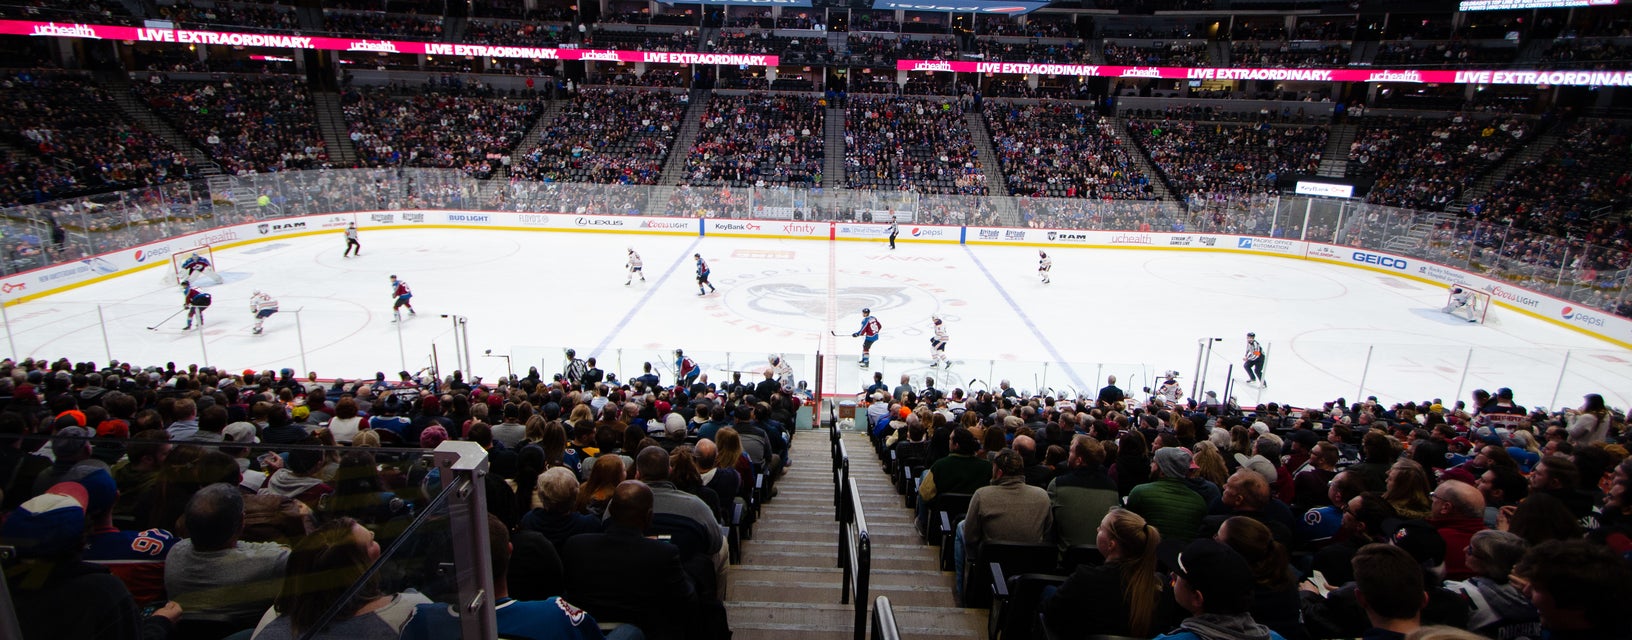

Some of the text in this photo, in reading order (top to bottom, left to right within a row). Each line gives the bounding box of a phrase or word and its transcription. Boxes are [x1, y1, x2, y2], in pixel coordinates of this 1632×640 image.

[34, 22, 95, 37] uchealth
[137, 28, 315, 49] LIVE EXTRAORDINARY.
[350, 40, 396, 52] uchealth
[425, 43, 559, 60] LIVE EXTRAORDINARY.
[581, 49, 619, 61] uchealth
[643, 52, 767, 66] LIVE EXTRAORDINARY.
[914, 60, 951, 71] uchealth
[976, 62, 1100, 76] LIVE EXTRAORDINARY.
[1123, 67, 1160, 78] uchealth
[1187, 68, 1332, 81] LIVE EXTRAORDINARY.
[1369, 70, 1419, 82] uchealth
[1454, 71, 1490, 83] LIVE
[273, 221, 306, 230] RAM
[647, 220, 669, 229] Coors
[715, 223, 744, 231] KeyBank
[783, 223, 815, 234] xfinity
[194, 230, 237, 247] uchealth
[922, 229, 943, 237] pepsi
[1112, 233, 1151, 244] uchealth
[147, 246, 171, 259] pepsi
[1352, 251, 1407, 270] GEICO
[1491, 286, 1539, 309] Coors LIGHT
[1574, 312, 1604, 327] pepsi
